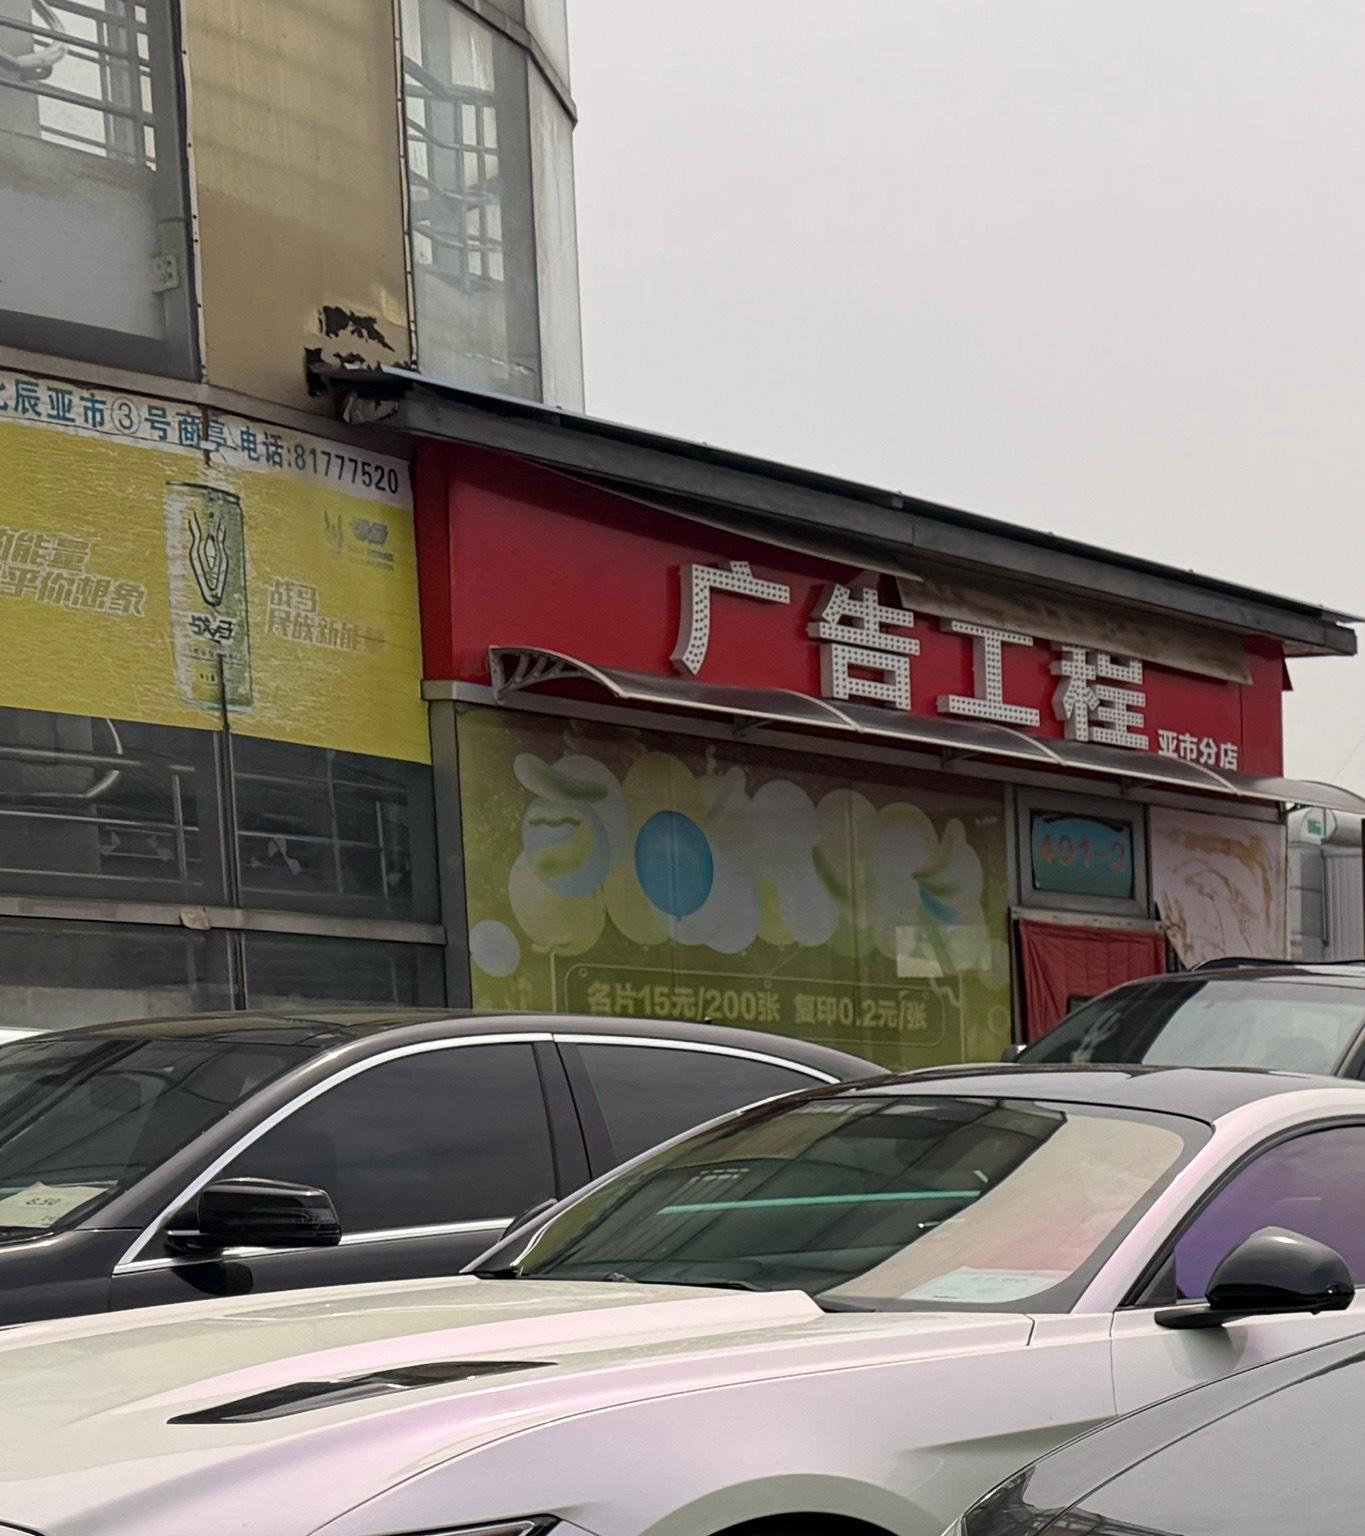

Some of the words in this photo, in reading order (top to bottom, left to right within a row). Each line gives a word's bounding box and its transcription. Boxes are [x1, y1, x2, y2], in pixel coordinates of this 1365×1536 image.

[241, 427, 399, 494] 电话:81777520
[266, 608, 386, 652] 民族新能
[670, 560, 1149, 749] 广告工程
[1157, 729, 1239, 771] 亚市分店
[1038, 834, 1127, 874] 401-2
[587, 982, 781, 1023] 名片15元/200张
[793, 989, 928, 1030] 复印0.2元/张
